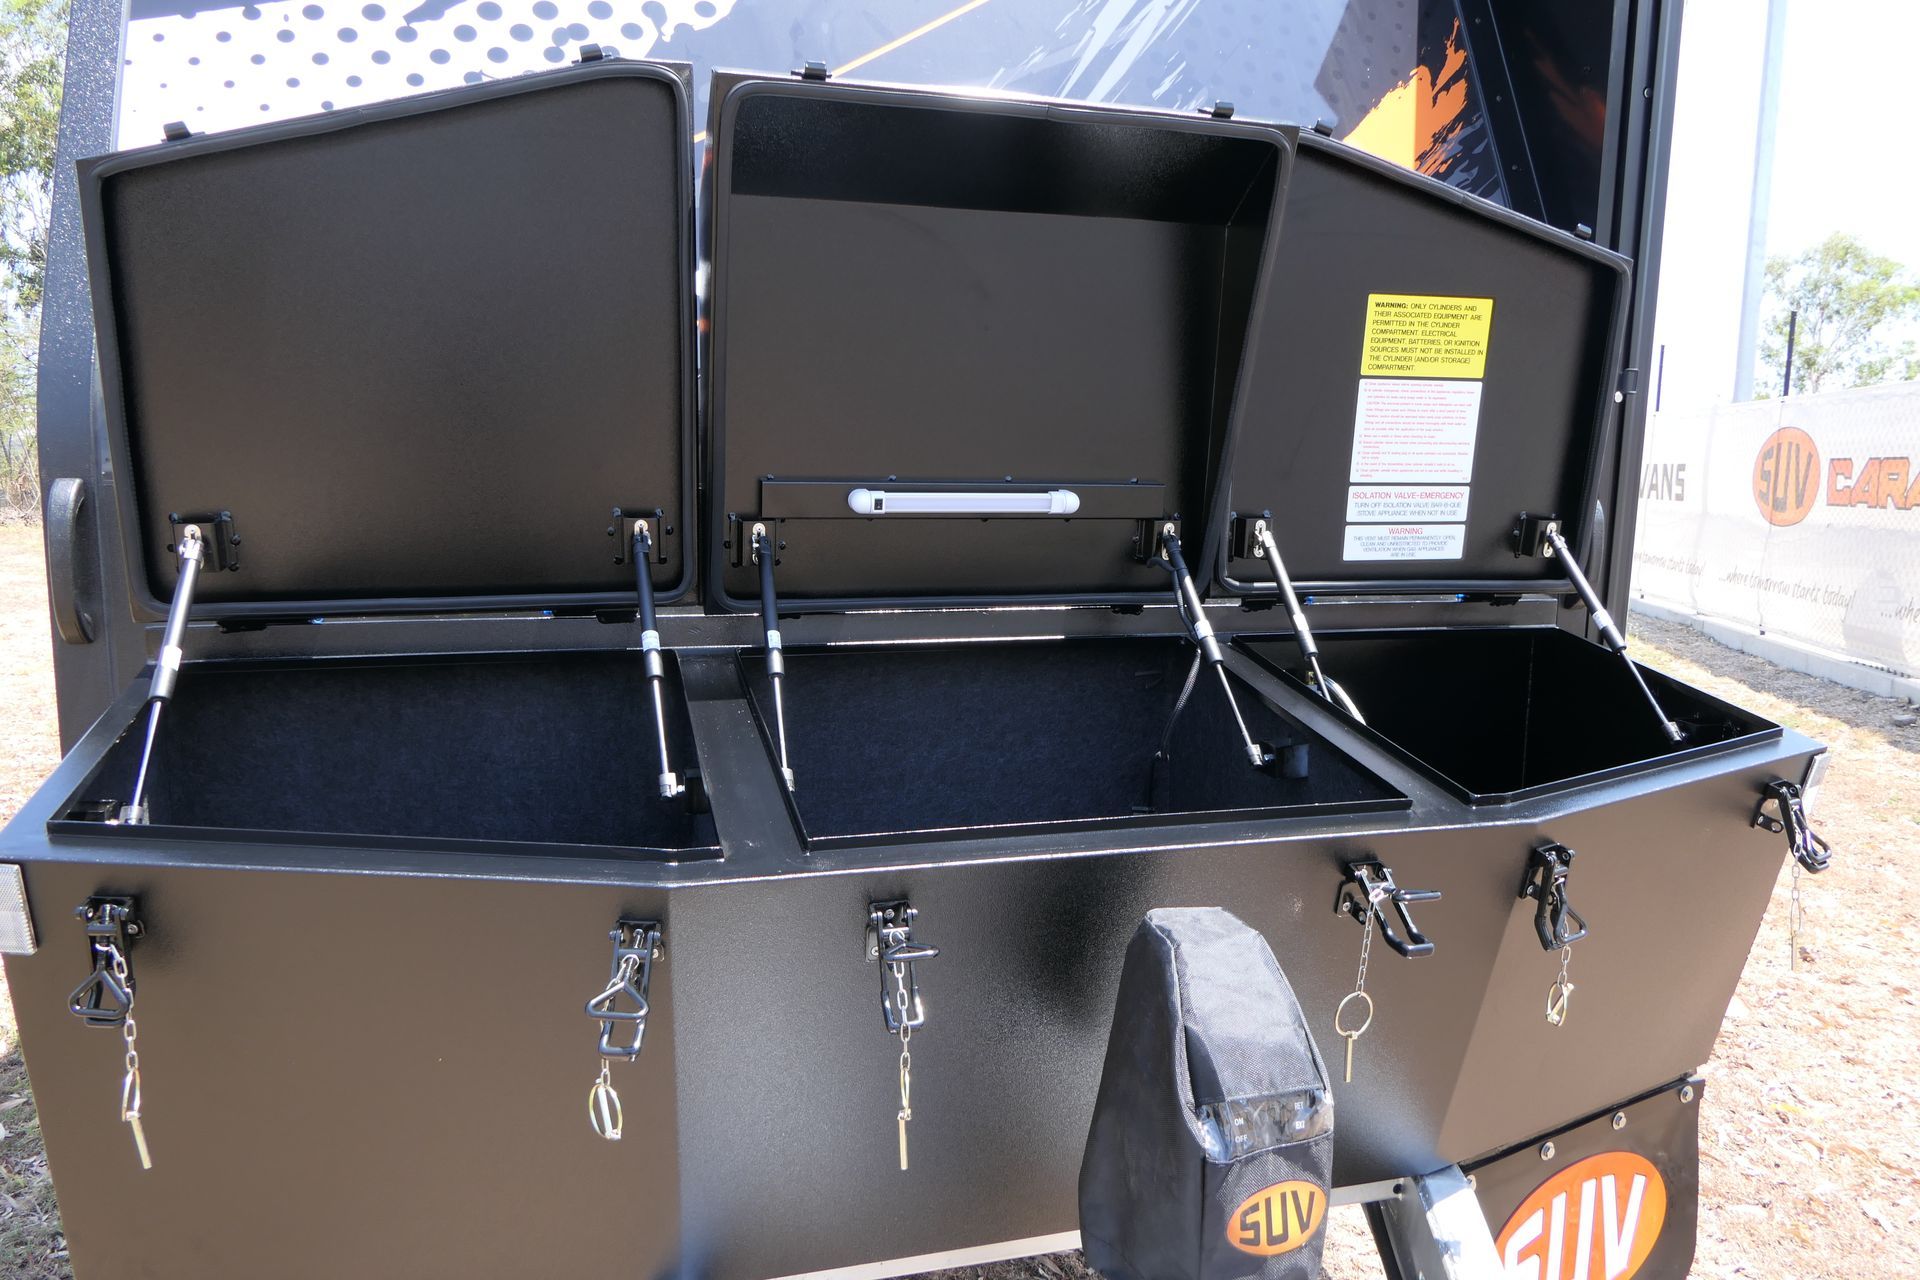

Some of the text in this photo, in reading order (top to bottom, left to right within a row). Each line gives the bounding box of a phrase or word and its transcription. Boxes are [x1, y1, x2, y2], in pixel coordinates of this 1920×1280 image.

[1394, 311, 1432, 319] ASSOCIATED
[1444, 348, 1476, 356] INSTALLED
[1758, 441, 1813, 513] SUV
[1235, 1118, 1244, 1126] ON
[1239, 1189, 1316, 1246] SUV
[1503, 1172, 1648, 1280] SUV
